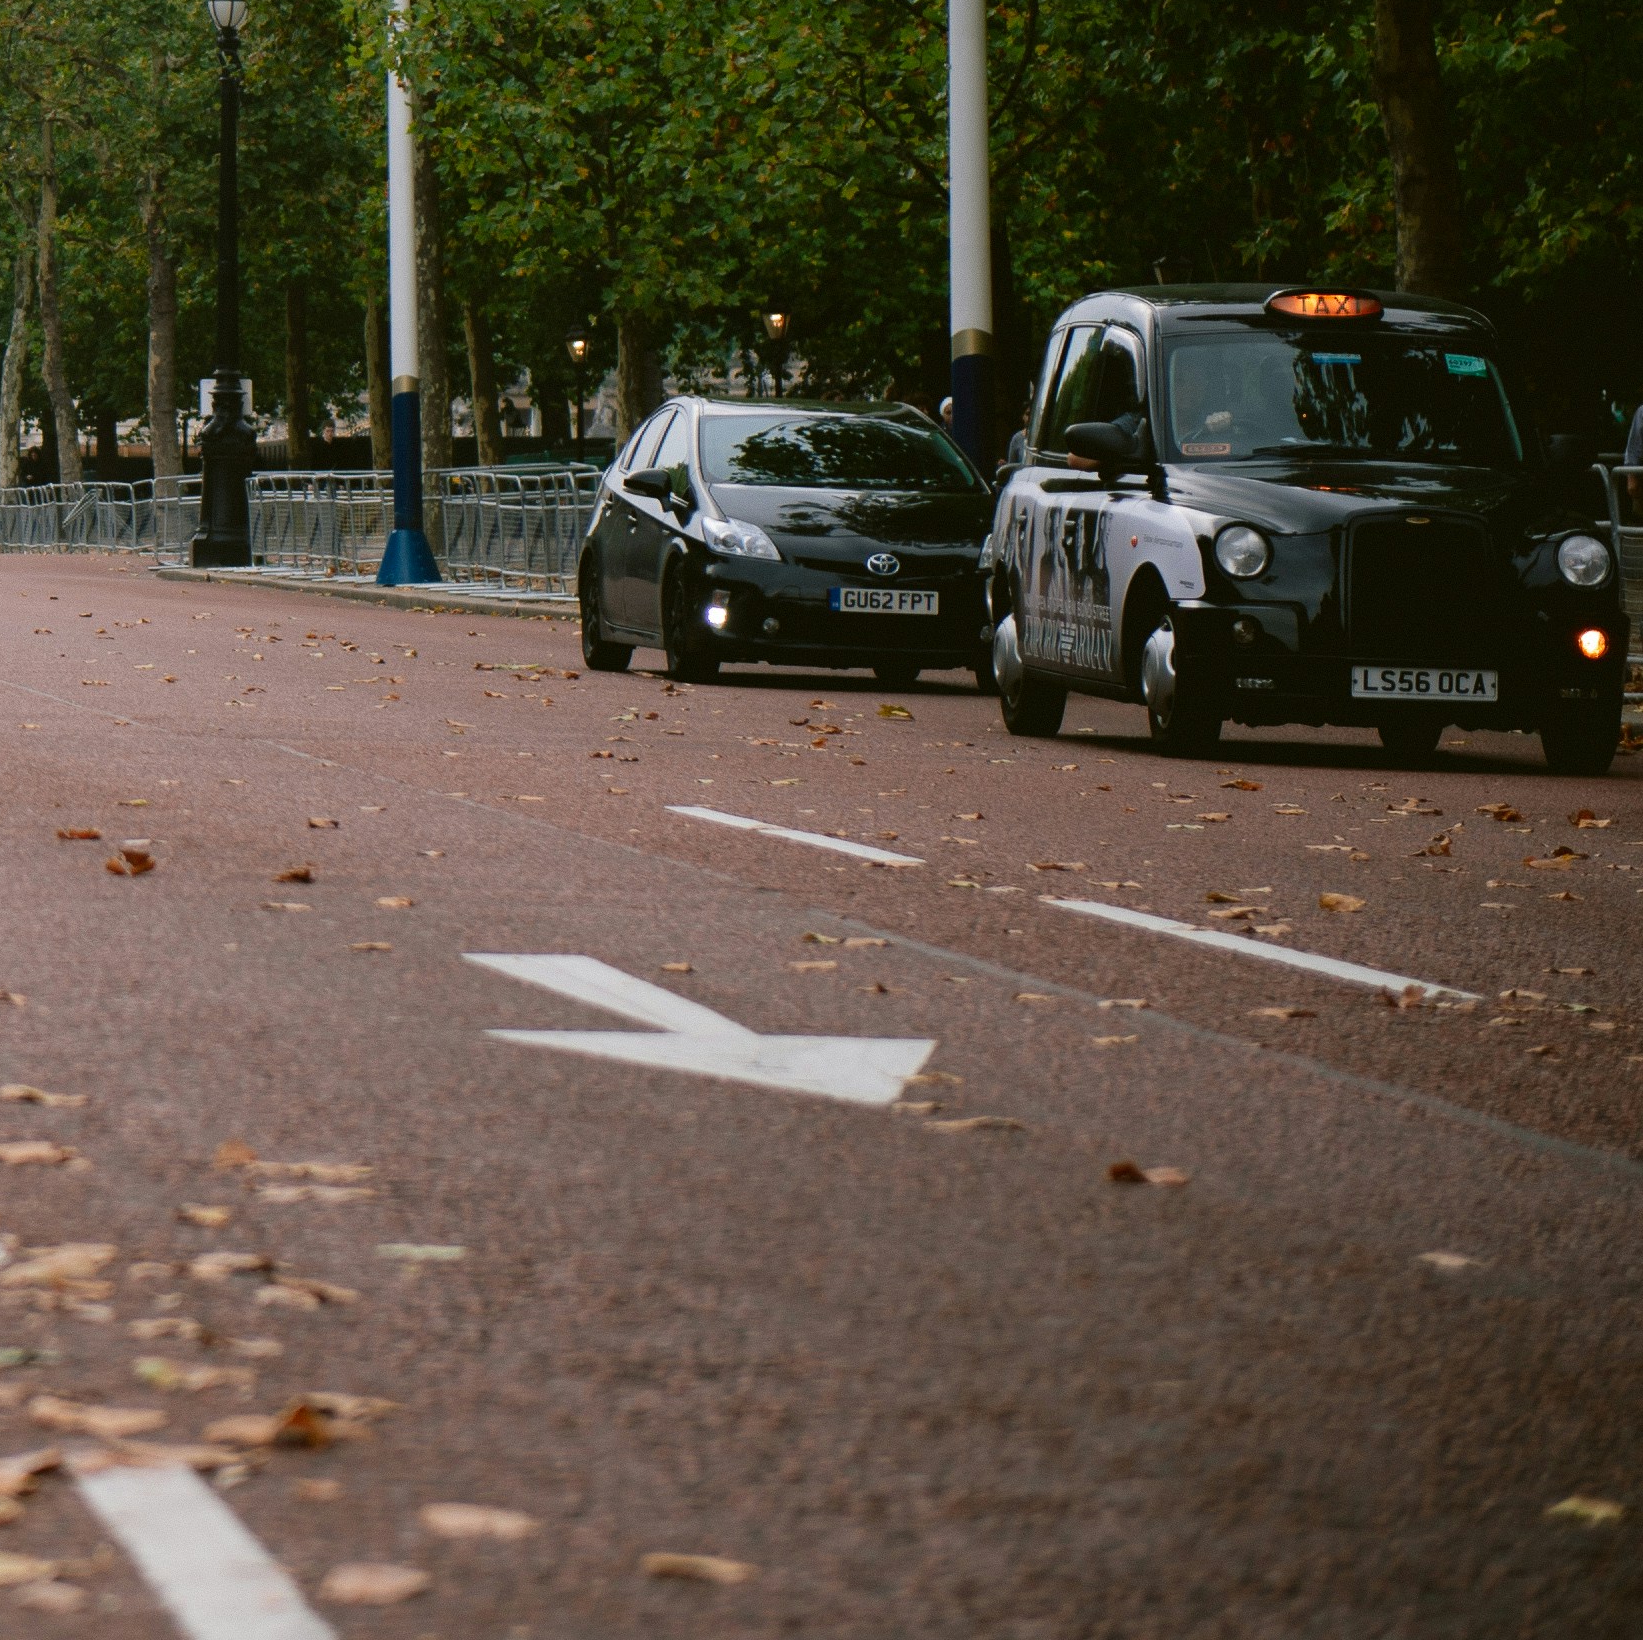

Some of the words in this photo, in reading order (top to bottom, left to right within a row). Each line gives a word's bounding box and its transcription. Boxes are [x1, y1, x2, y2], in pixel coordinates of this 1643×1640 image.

[1296, 295, 1361, 314] TAXI
[844, 590, 893, 609] GU62
[899, 593, 935, 611] FPT
[1363, 669, 1431, 693] LS56
[1438, 672, 1486, 695] OCA
